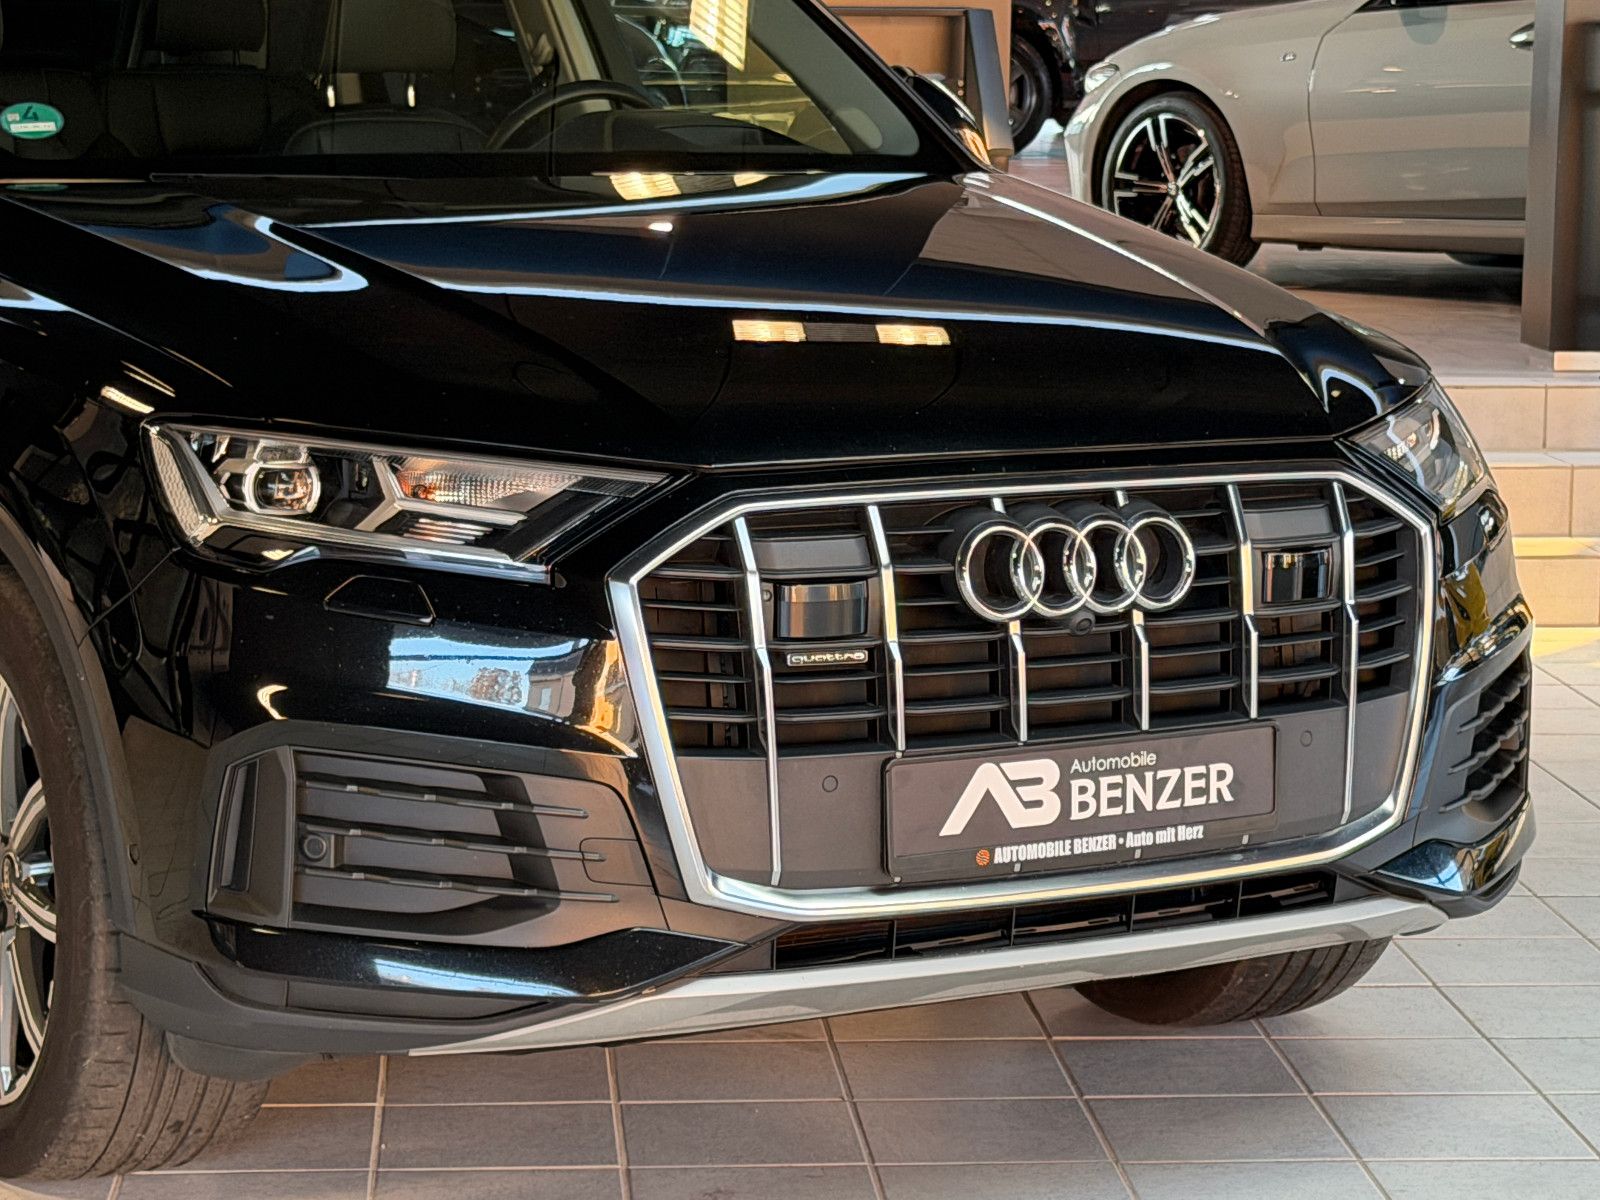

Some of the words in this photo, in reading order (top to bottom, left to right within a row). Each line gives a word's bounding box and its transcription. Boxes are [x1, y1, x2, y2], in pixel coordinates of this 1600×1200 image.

[21, 105, 39, 121] 4
[791, 652, 865, 665] quattro
[1070, 751, 1157, 774] Automobile
[1070, 762, 1235, 821] BENZER
[993, 839, 1072, 864] AUTOMOBILE
[1073, 834, 1117, 855] BENZER
[1125, 831, 1154, 848] Auto
[1155, 826, 1176, 844] mit
[1177, 825, 1204, 841] Herz
